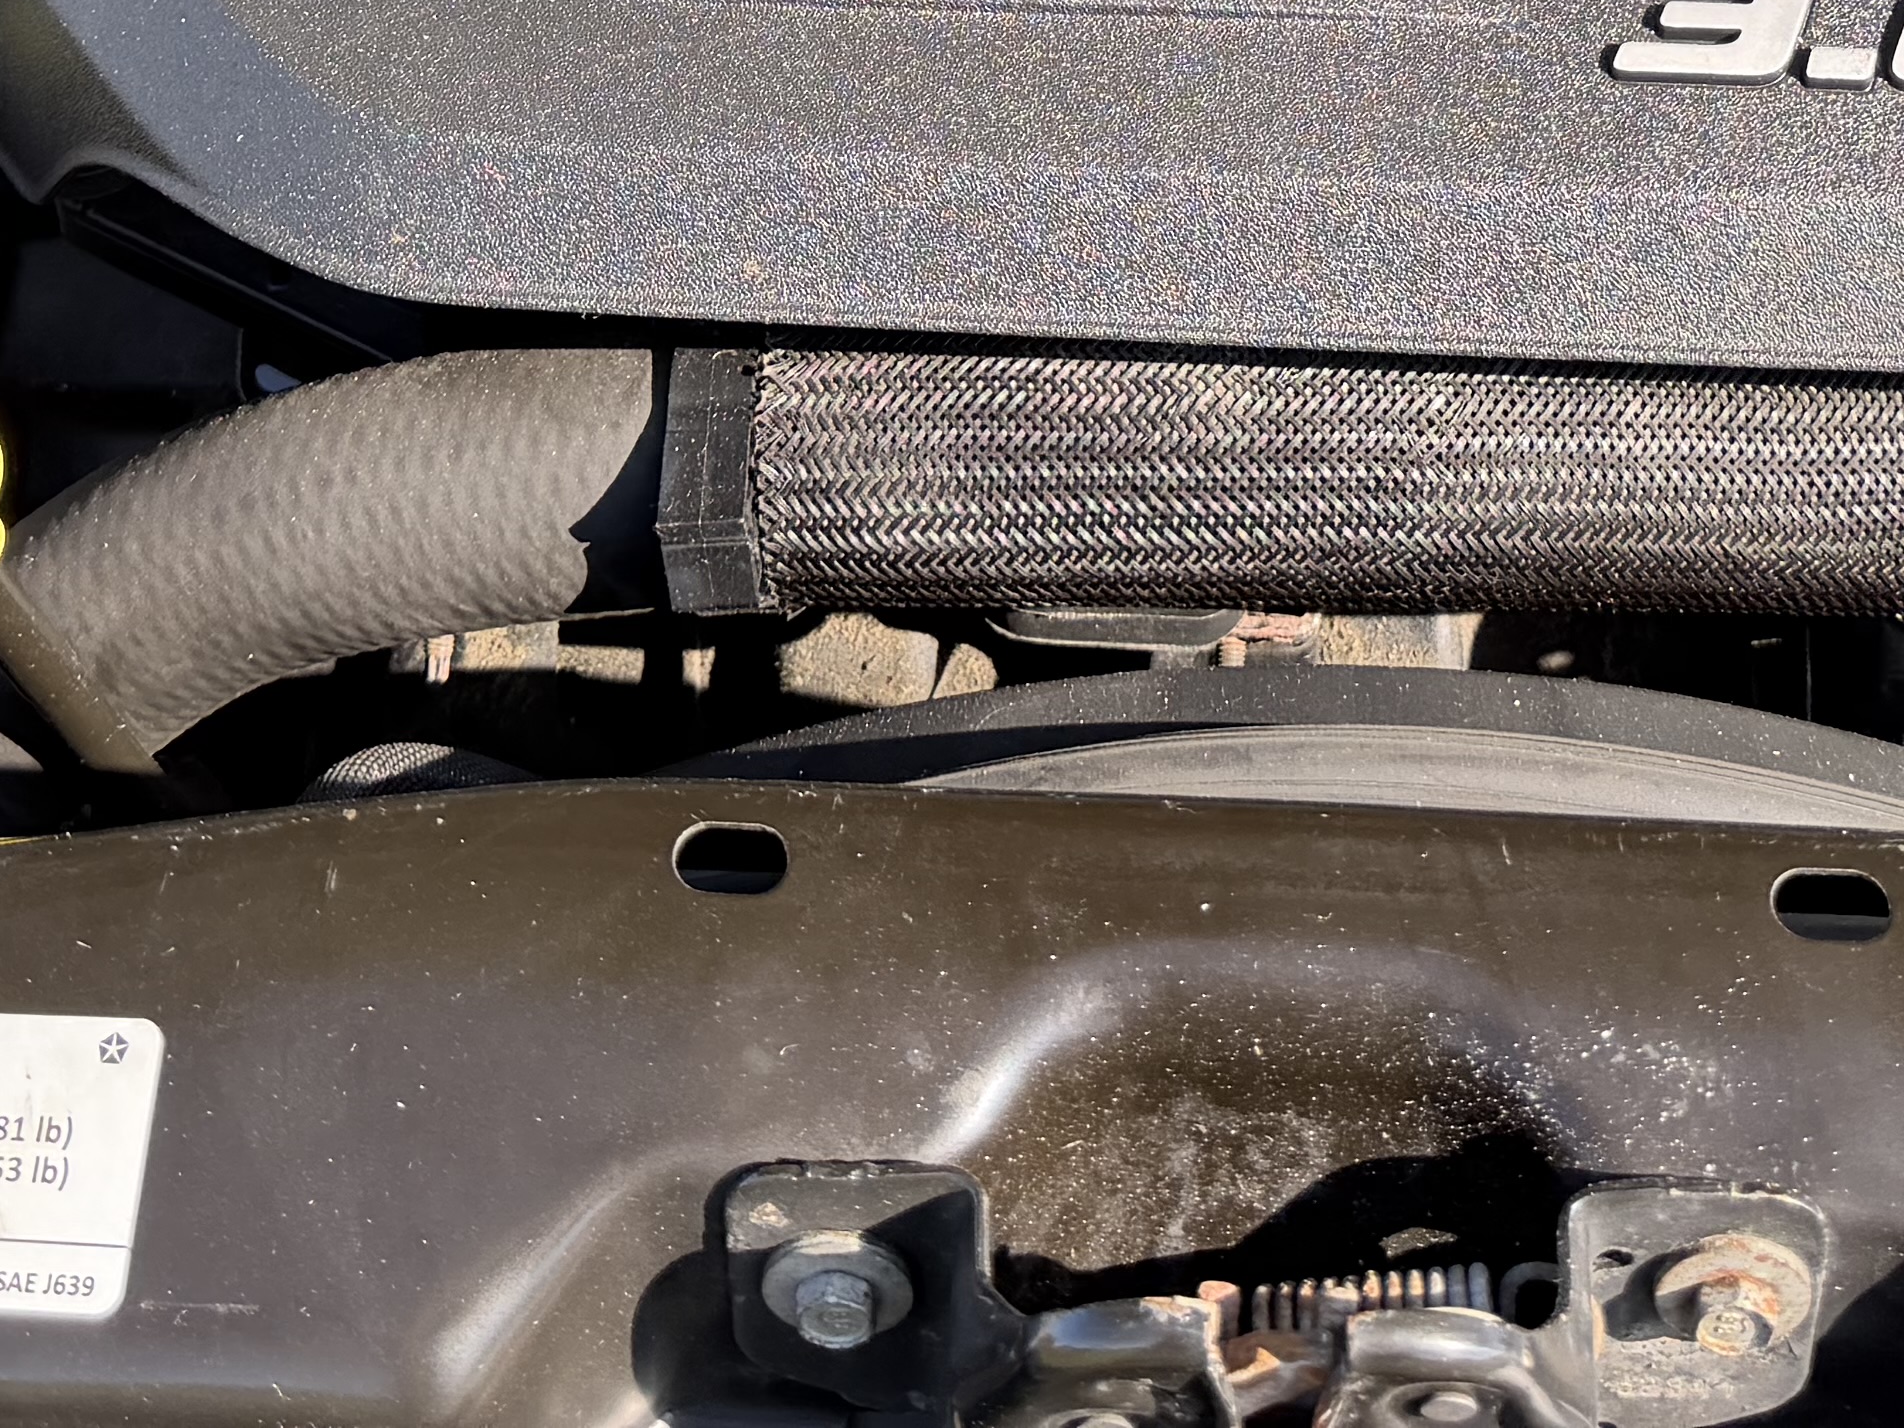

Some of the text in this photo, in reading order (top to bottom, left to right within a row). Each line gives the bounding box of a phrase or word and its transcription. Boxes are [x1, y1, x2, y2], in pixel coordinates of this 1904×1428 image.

[36, 1114, 75, 1151] lb)
[31, 1154, 72, 1192] lb)
[41, 1272, 96, 1298] J639
